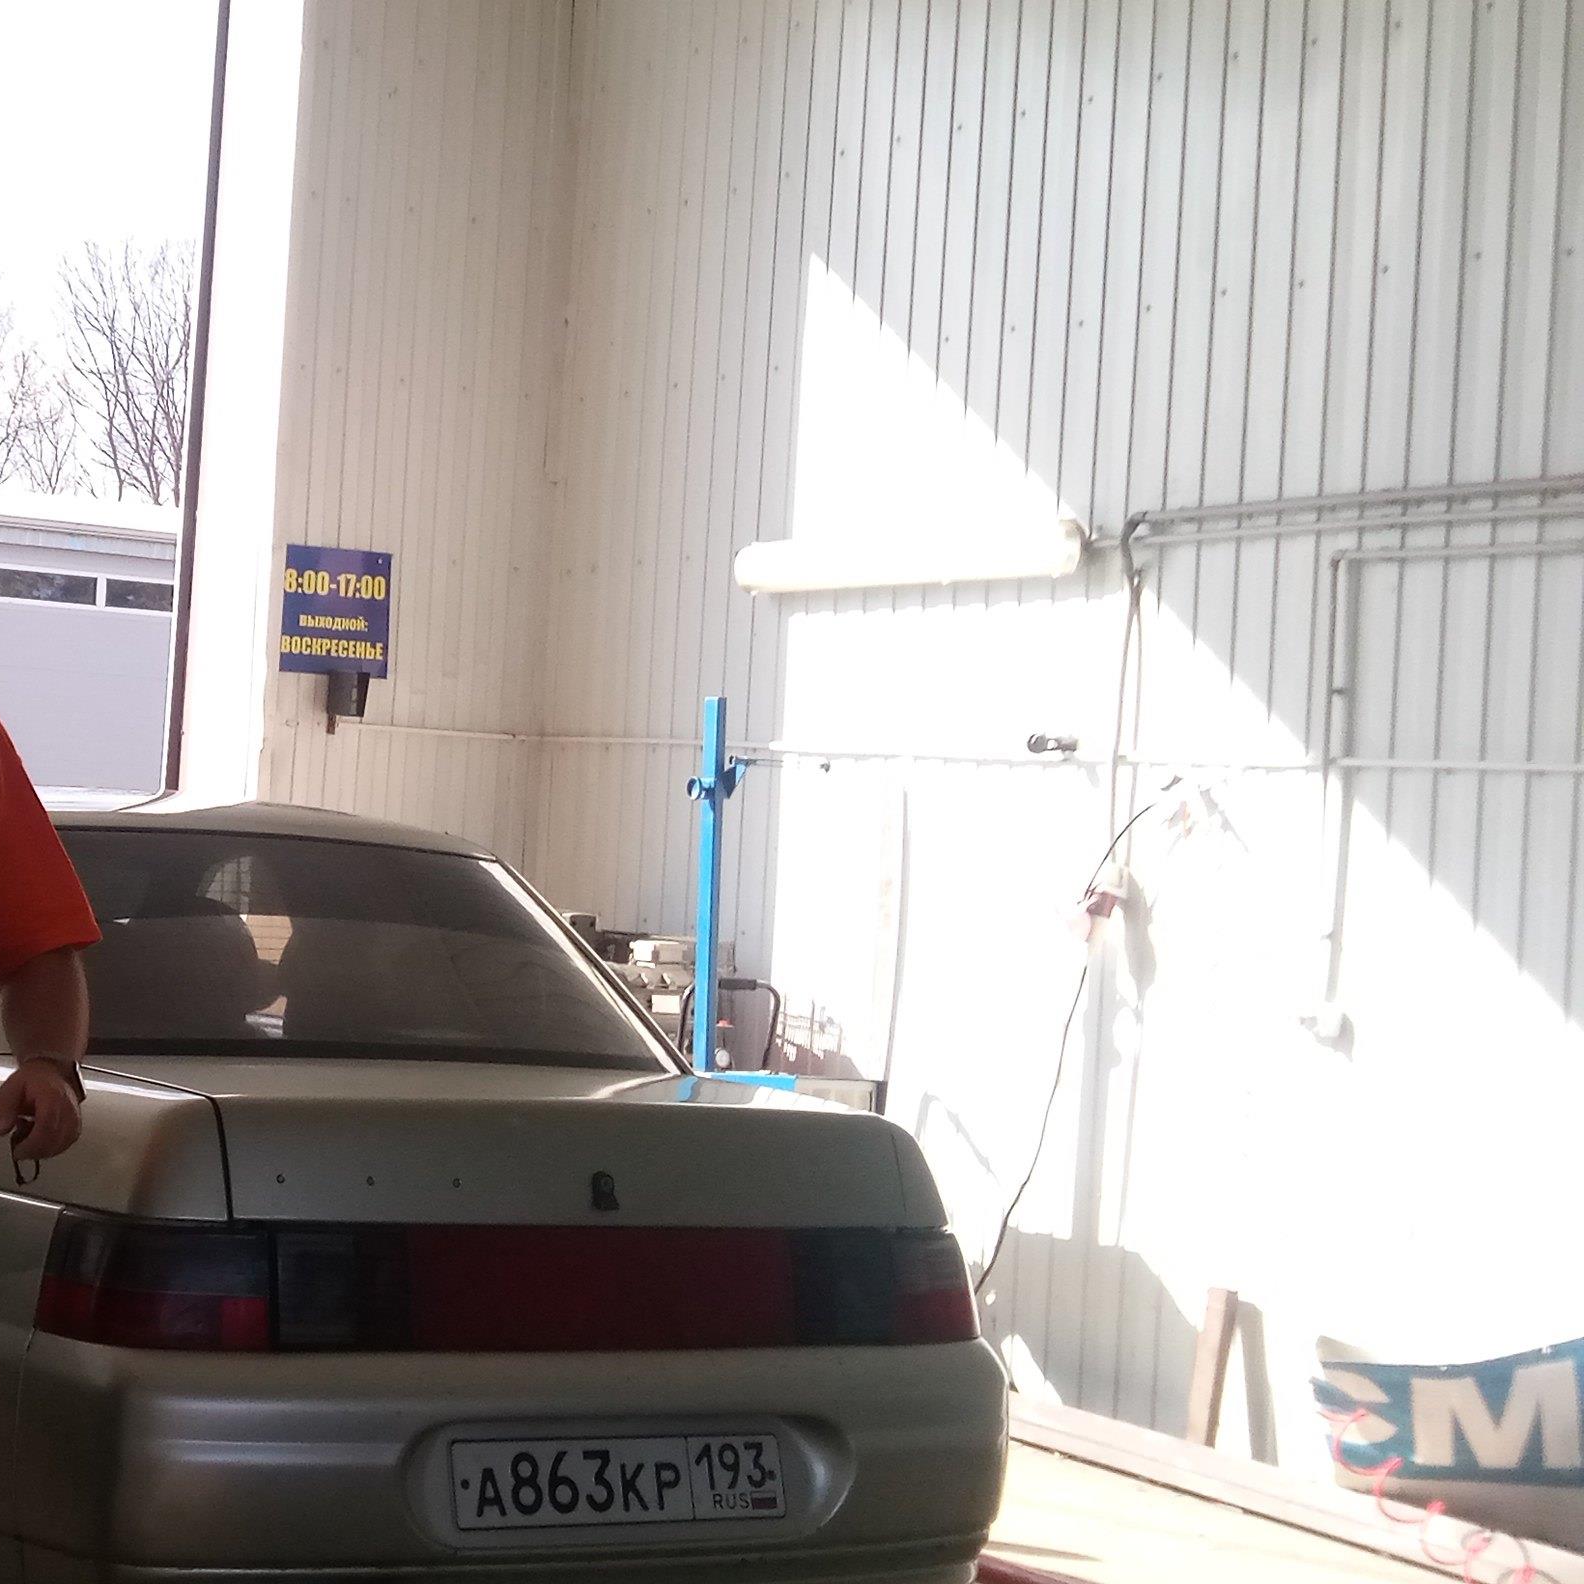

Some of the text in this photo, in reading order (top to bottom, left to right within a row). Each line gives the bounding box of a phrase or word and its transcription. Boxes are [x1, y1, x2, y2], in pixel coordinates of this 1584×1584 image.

[283, 568, 386, 600] 8:00-17:00
[280, 635, 384, 660] ВОСКРЕСЕНЬЕ
[695, 1442, 767, 1490] 193
[712, 1491, 750, 1510] RUS
